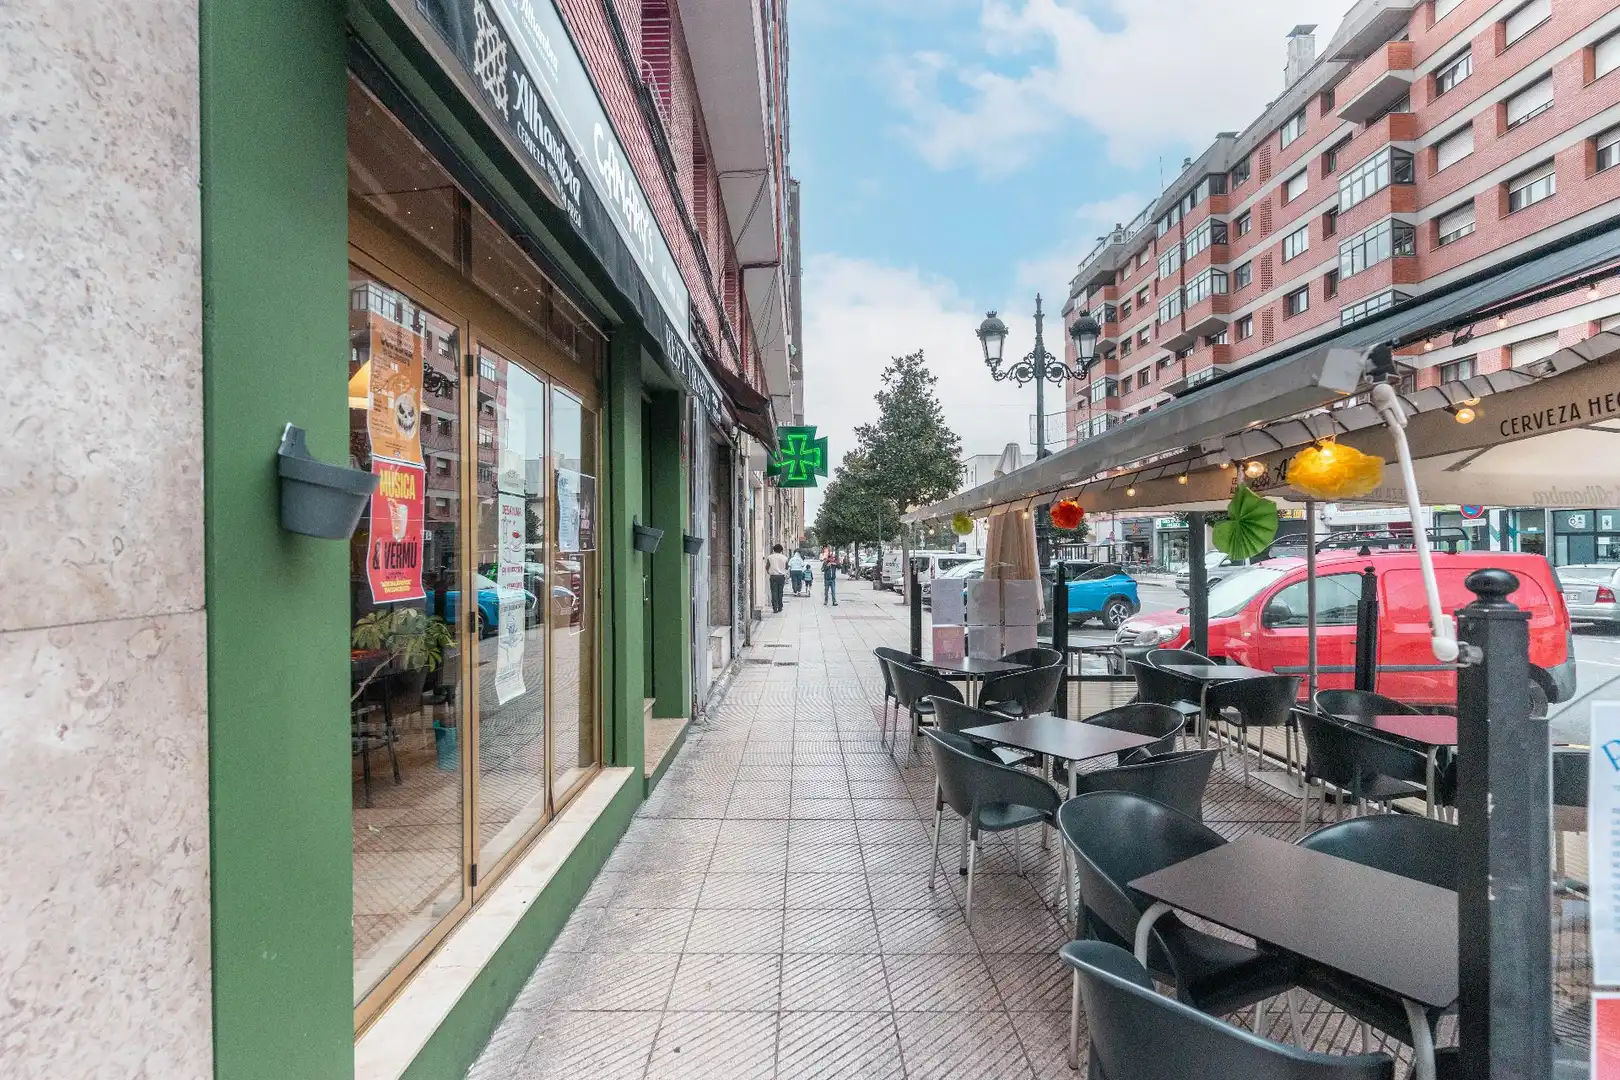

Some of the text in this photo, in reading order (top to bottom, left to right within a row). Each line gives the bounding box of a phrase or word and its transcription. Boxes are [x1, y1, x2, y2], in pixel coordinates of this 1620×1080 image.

[513, 70, 581, 206] Alhambra
[517, 121, 546, 170] CERVEZA
[1500, 402, 1581, 437] CERVEZA
[380, 467, 416, 500] MÚSICA
[384, 536, 418, 570] VERMÚ
